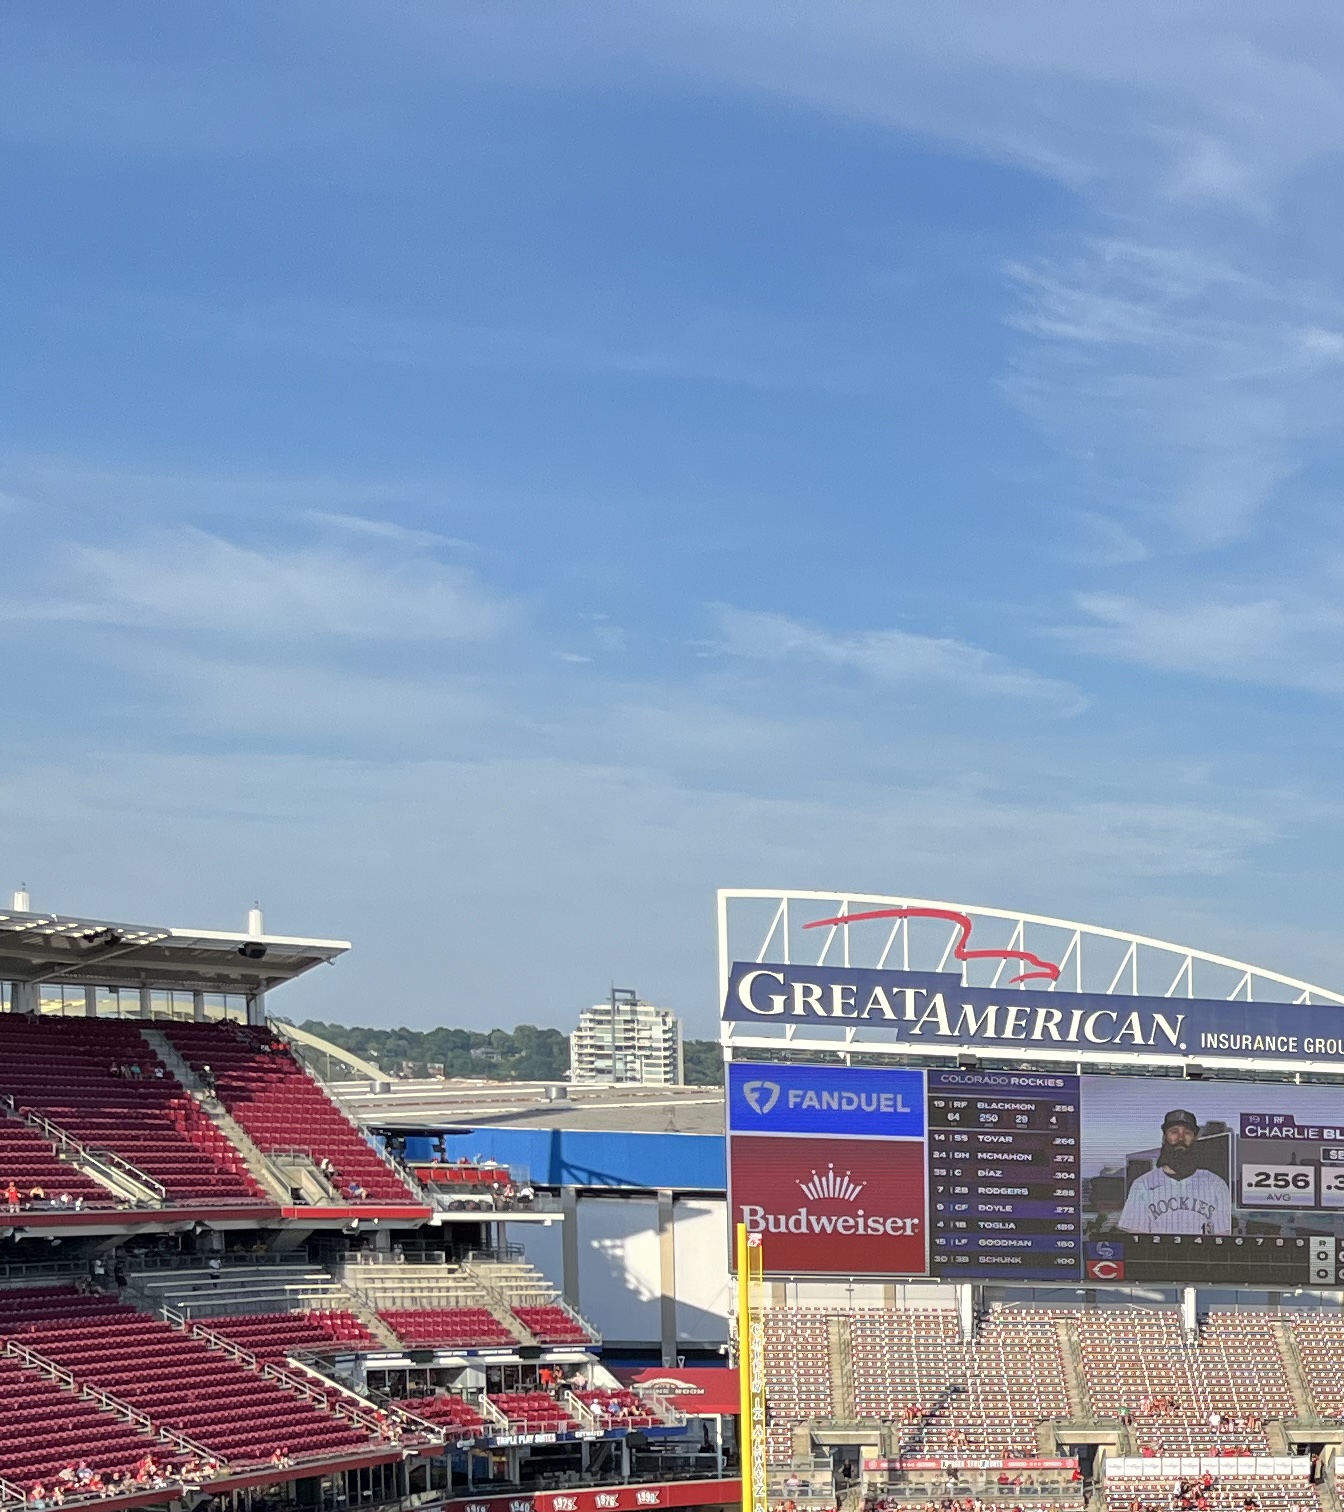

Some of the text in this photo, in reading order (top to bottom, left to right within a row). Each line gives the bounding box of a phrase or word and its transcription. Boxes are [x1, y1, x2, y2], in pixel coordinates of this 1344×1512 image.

[1201, 1033, 1298, 1053] INSURANCE
[940, 1074, 1065, 1087] COLORADO ROCKIES
[788, 1089, 911, 1113] FANDUEL
[977, 1102, 1035, 1111] BLACKMON
[1245, 1125, 1320, 1139] CHARLIE
[977, 1135, 1013, 1143] TOVAR
[977, 1153, 1032, 1161] MCMAHON
[977, 1168, 1003, 1177] DÍAZ
[1246, 1172, 1311, 1190] .256
[978, 1187, 1029, 1195] RODGERS
[1148, 1196, 1216, 1222] ROCKIES
[739, 1205, 919, 1236] Budweiser
[978, 1239, 1032, 1247] GOODMAN
[978, 1256, 1022, 1264] SCHUNK
